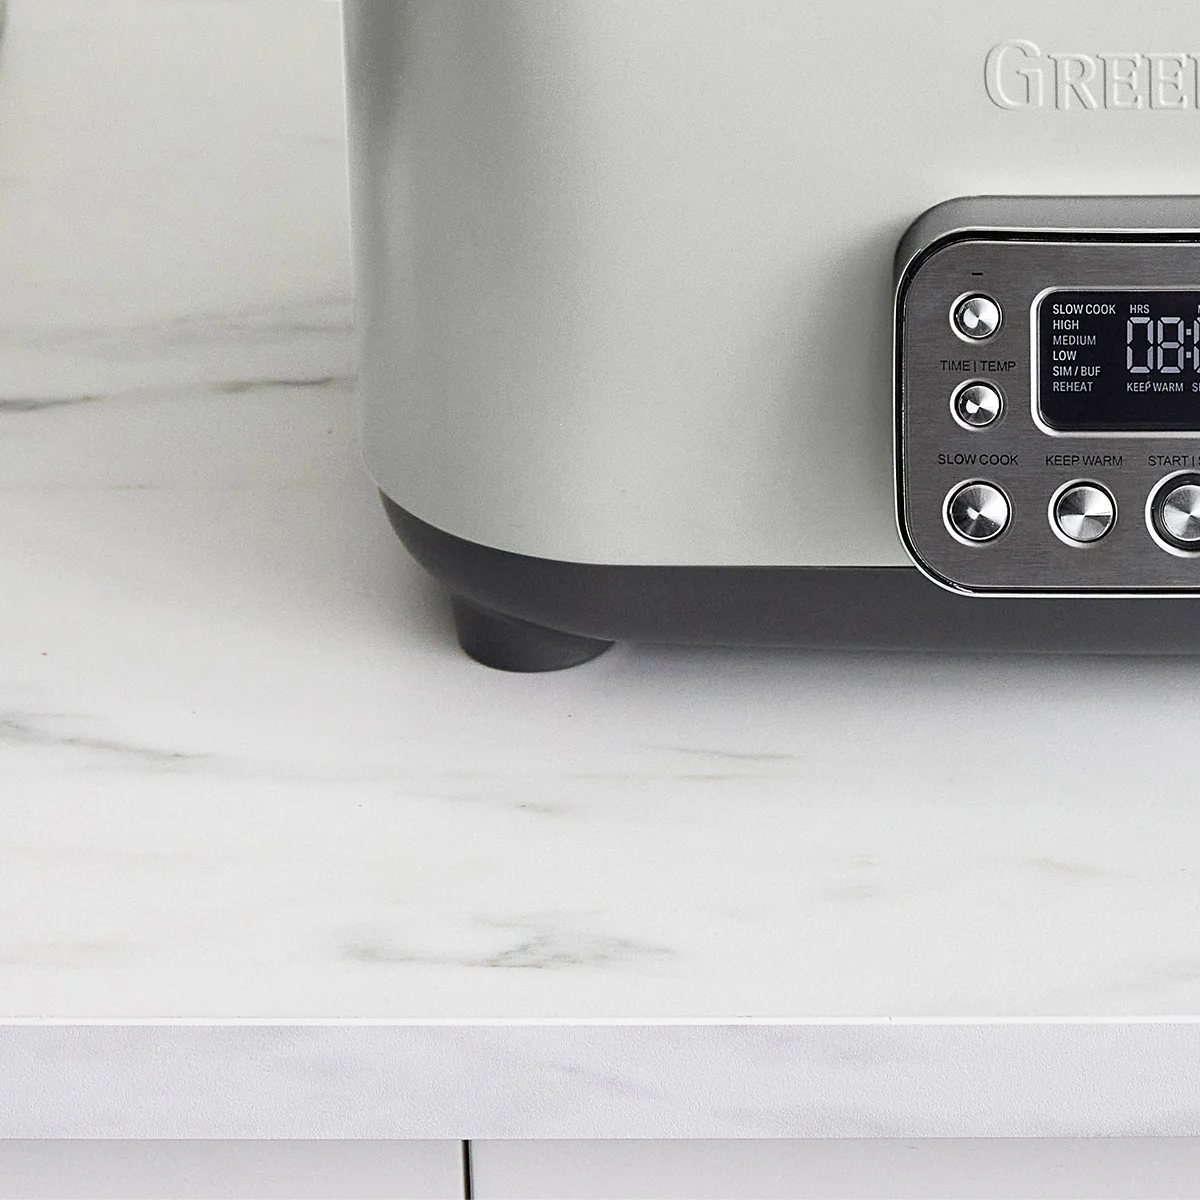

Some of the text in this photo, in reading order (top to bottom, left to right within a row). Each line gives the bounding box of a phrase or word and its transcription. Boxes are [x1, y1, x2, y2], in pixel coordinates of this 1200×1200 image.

[1052, 304, 1116, 315] SLOW COOK
[1129, 304, 1150, 315] HRS
[1052, 320, 1080, 330] HIGH
[1052, 335, 1097, 346] MEDIUM
[1052, 350, 1077, 361] LOW
[940, 360, 971, 372] TIME
[980, 360, 1017, 372] TEMP
[1052, 366, 1073, 377] SIM
[1081, 366, 1101, 377] BUF
[1052, 381, 1094, 392] REHEAT
[1126, 382, 1184, 392] KEEP WARM
[937, 453, 1019, 465] SLOW COOK
[1045, 454, 1123, 466] KEEP WARM
[1147, 455, 1189, 467] START
